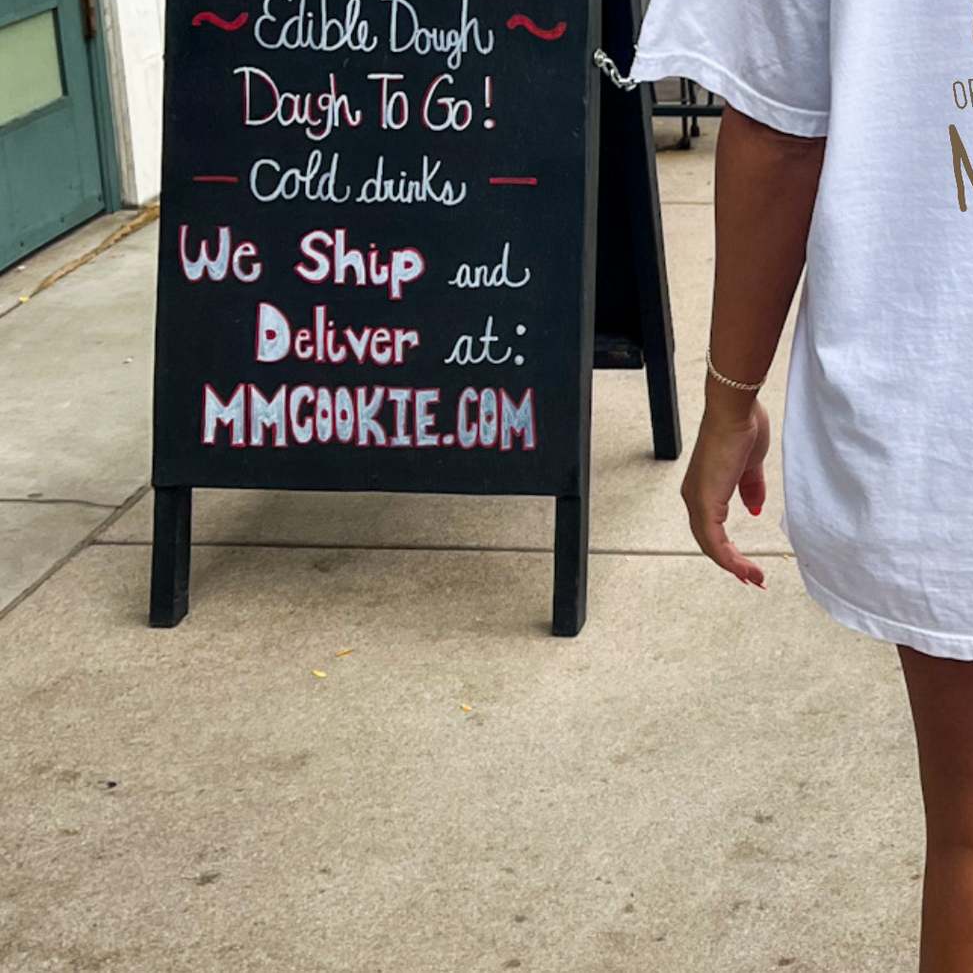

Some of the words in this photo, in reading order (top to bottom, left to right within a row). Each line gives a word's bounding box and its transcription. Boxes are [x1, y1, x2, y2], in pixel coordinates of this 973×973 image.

[234, 67, 361, 140] Dough
[367, 73, 408, 129] To
[250, 150, 350, 202] Cold
[178, 223, 263, 284] We
[294, 229, 425, 299] Ship
[448, 242, 530, 288] and
[255, 302, 419, 365] Deliver
[444, 316, 526, 365] at:
[202, 383, 537, 450] MMCOOKIE.COM
